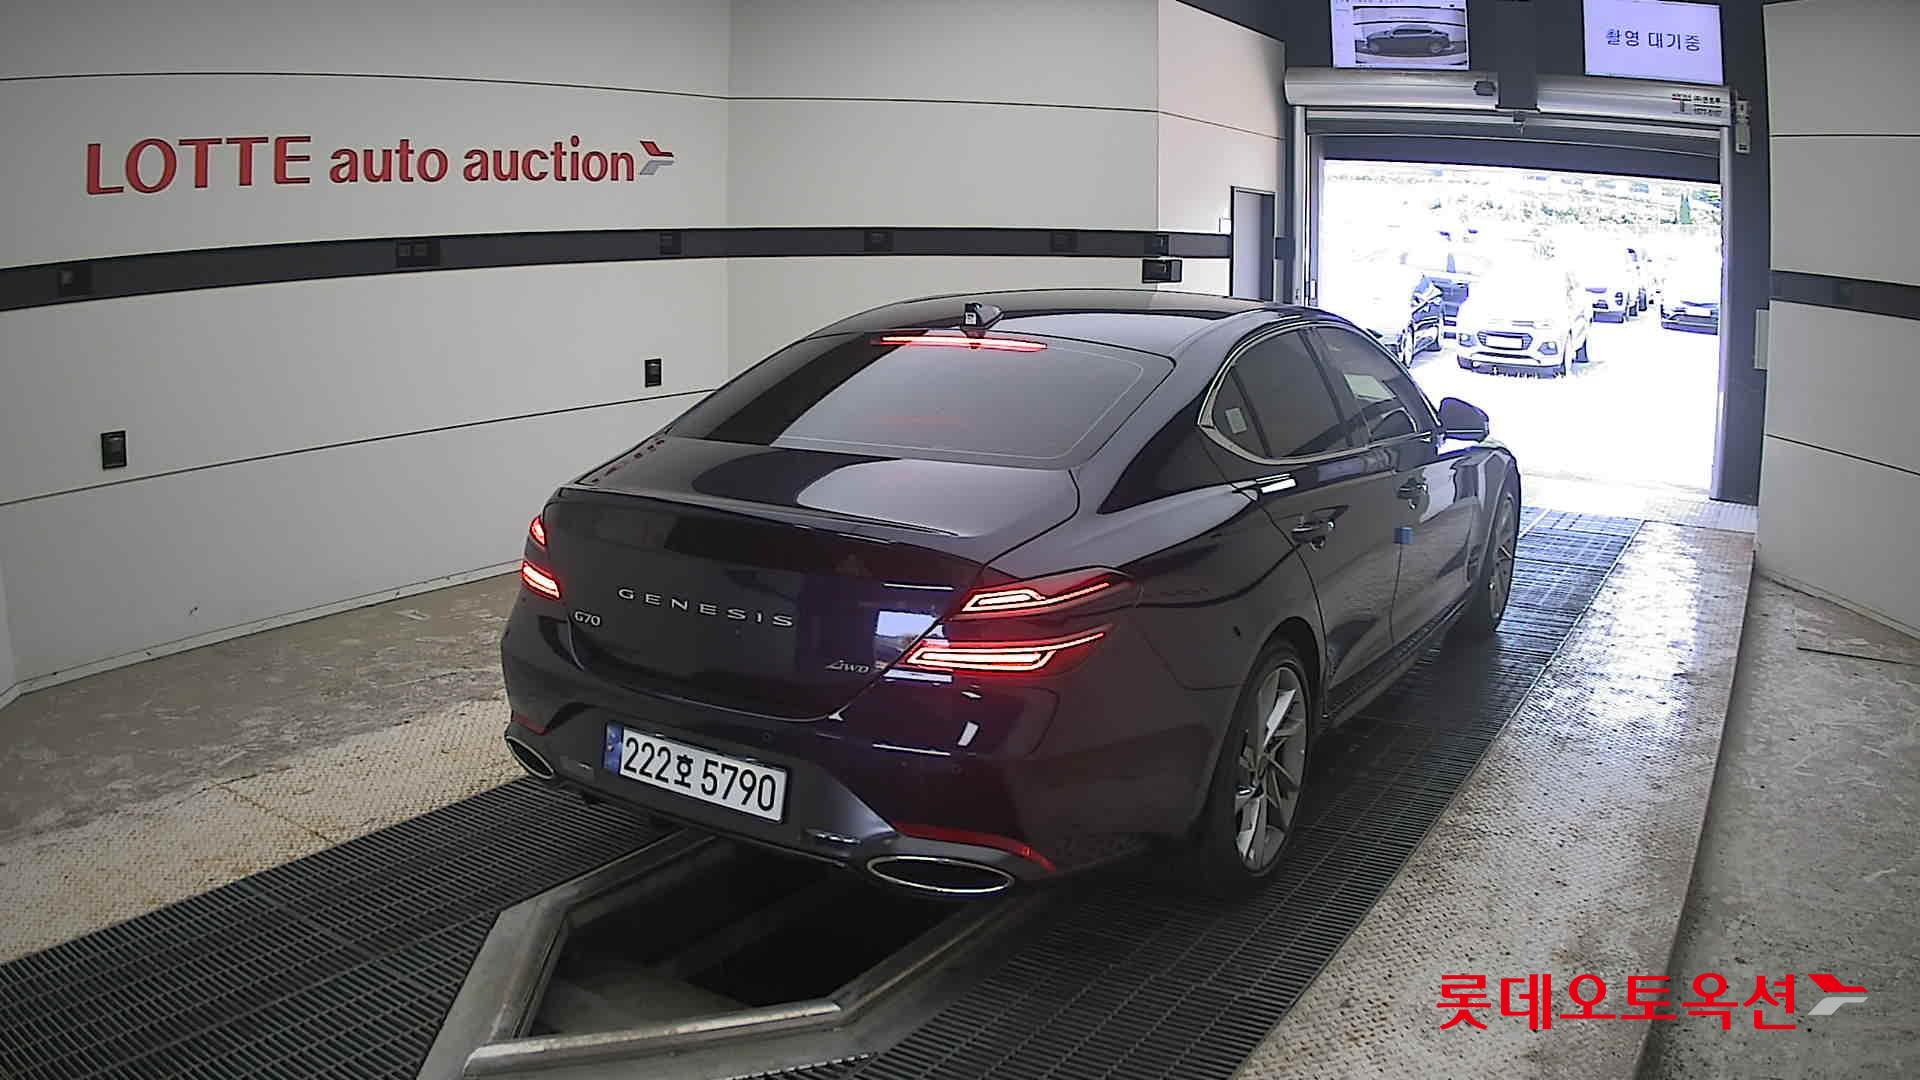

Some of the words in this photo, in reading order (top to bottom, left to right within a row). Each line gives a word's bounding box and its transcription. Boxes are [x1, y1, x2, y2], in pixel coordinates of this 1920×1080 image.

[87, 136, 312, 195] LOTTE
[328, 138, 450, 184] auto
[463, 135, 636, 183] auction
[573, 610, 602, 627] G70
[618, 587, 794, 627] GENESIS
[623, 736, 693, 789] 222호
[700, 758, 777, 812] 5790
